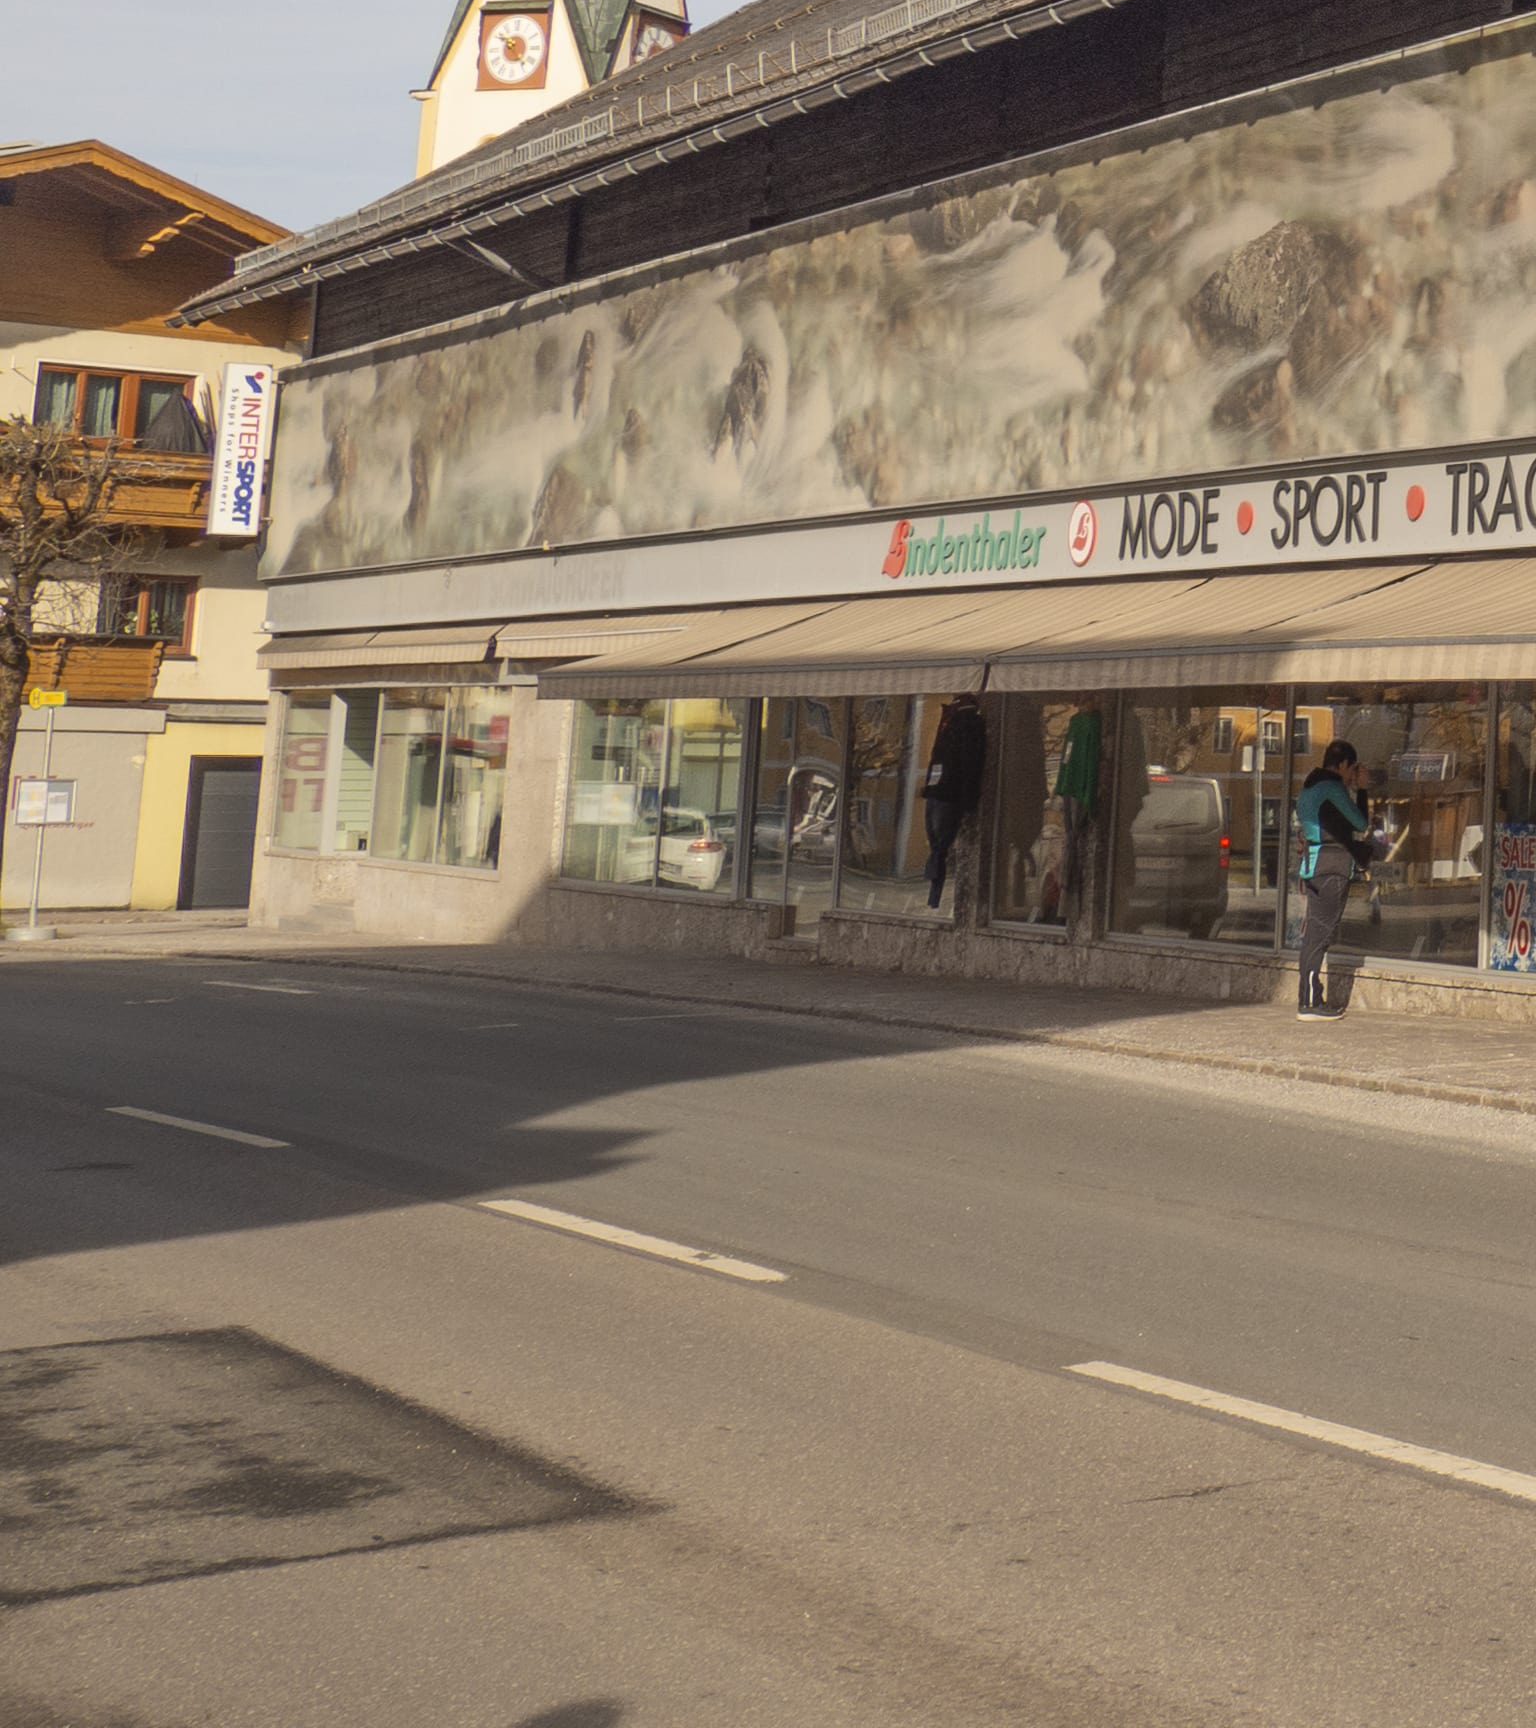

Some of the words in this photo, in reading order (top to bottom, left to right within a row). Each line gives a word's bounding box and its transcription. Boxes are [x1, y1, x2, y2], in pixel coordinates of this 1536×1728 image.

[227, 388, 240, 427] Shops
[225, 433, 235, 452] for
[231, 397, 262, 526] INTERSPORT
[219, 459, 233, 513] Winners
[881, 509, 1047, 579] Lindenthaler
[1118, 487, 1221, 561] MODE
[1270, 471, 1388, 550] SPORT
[1501, 836, 1536, 869] SALE
[1504, 882, 1530, 956] %
